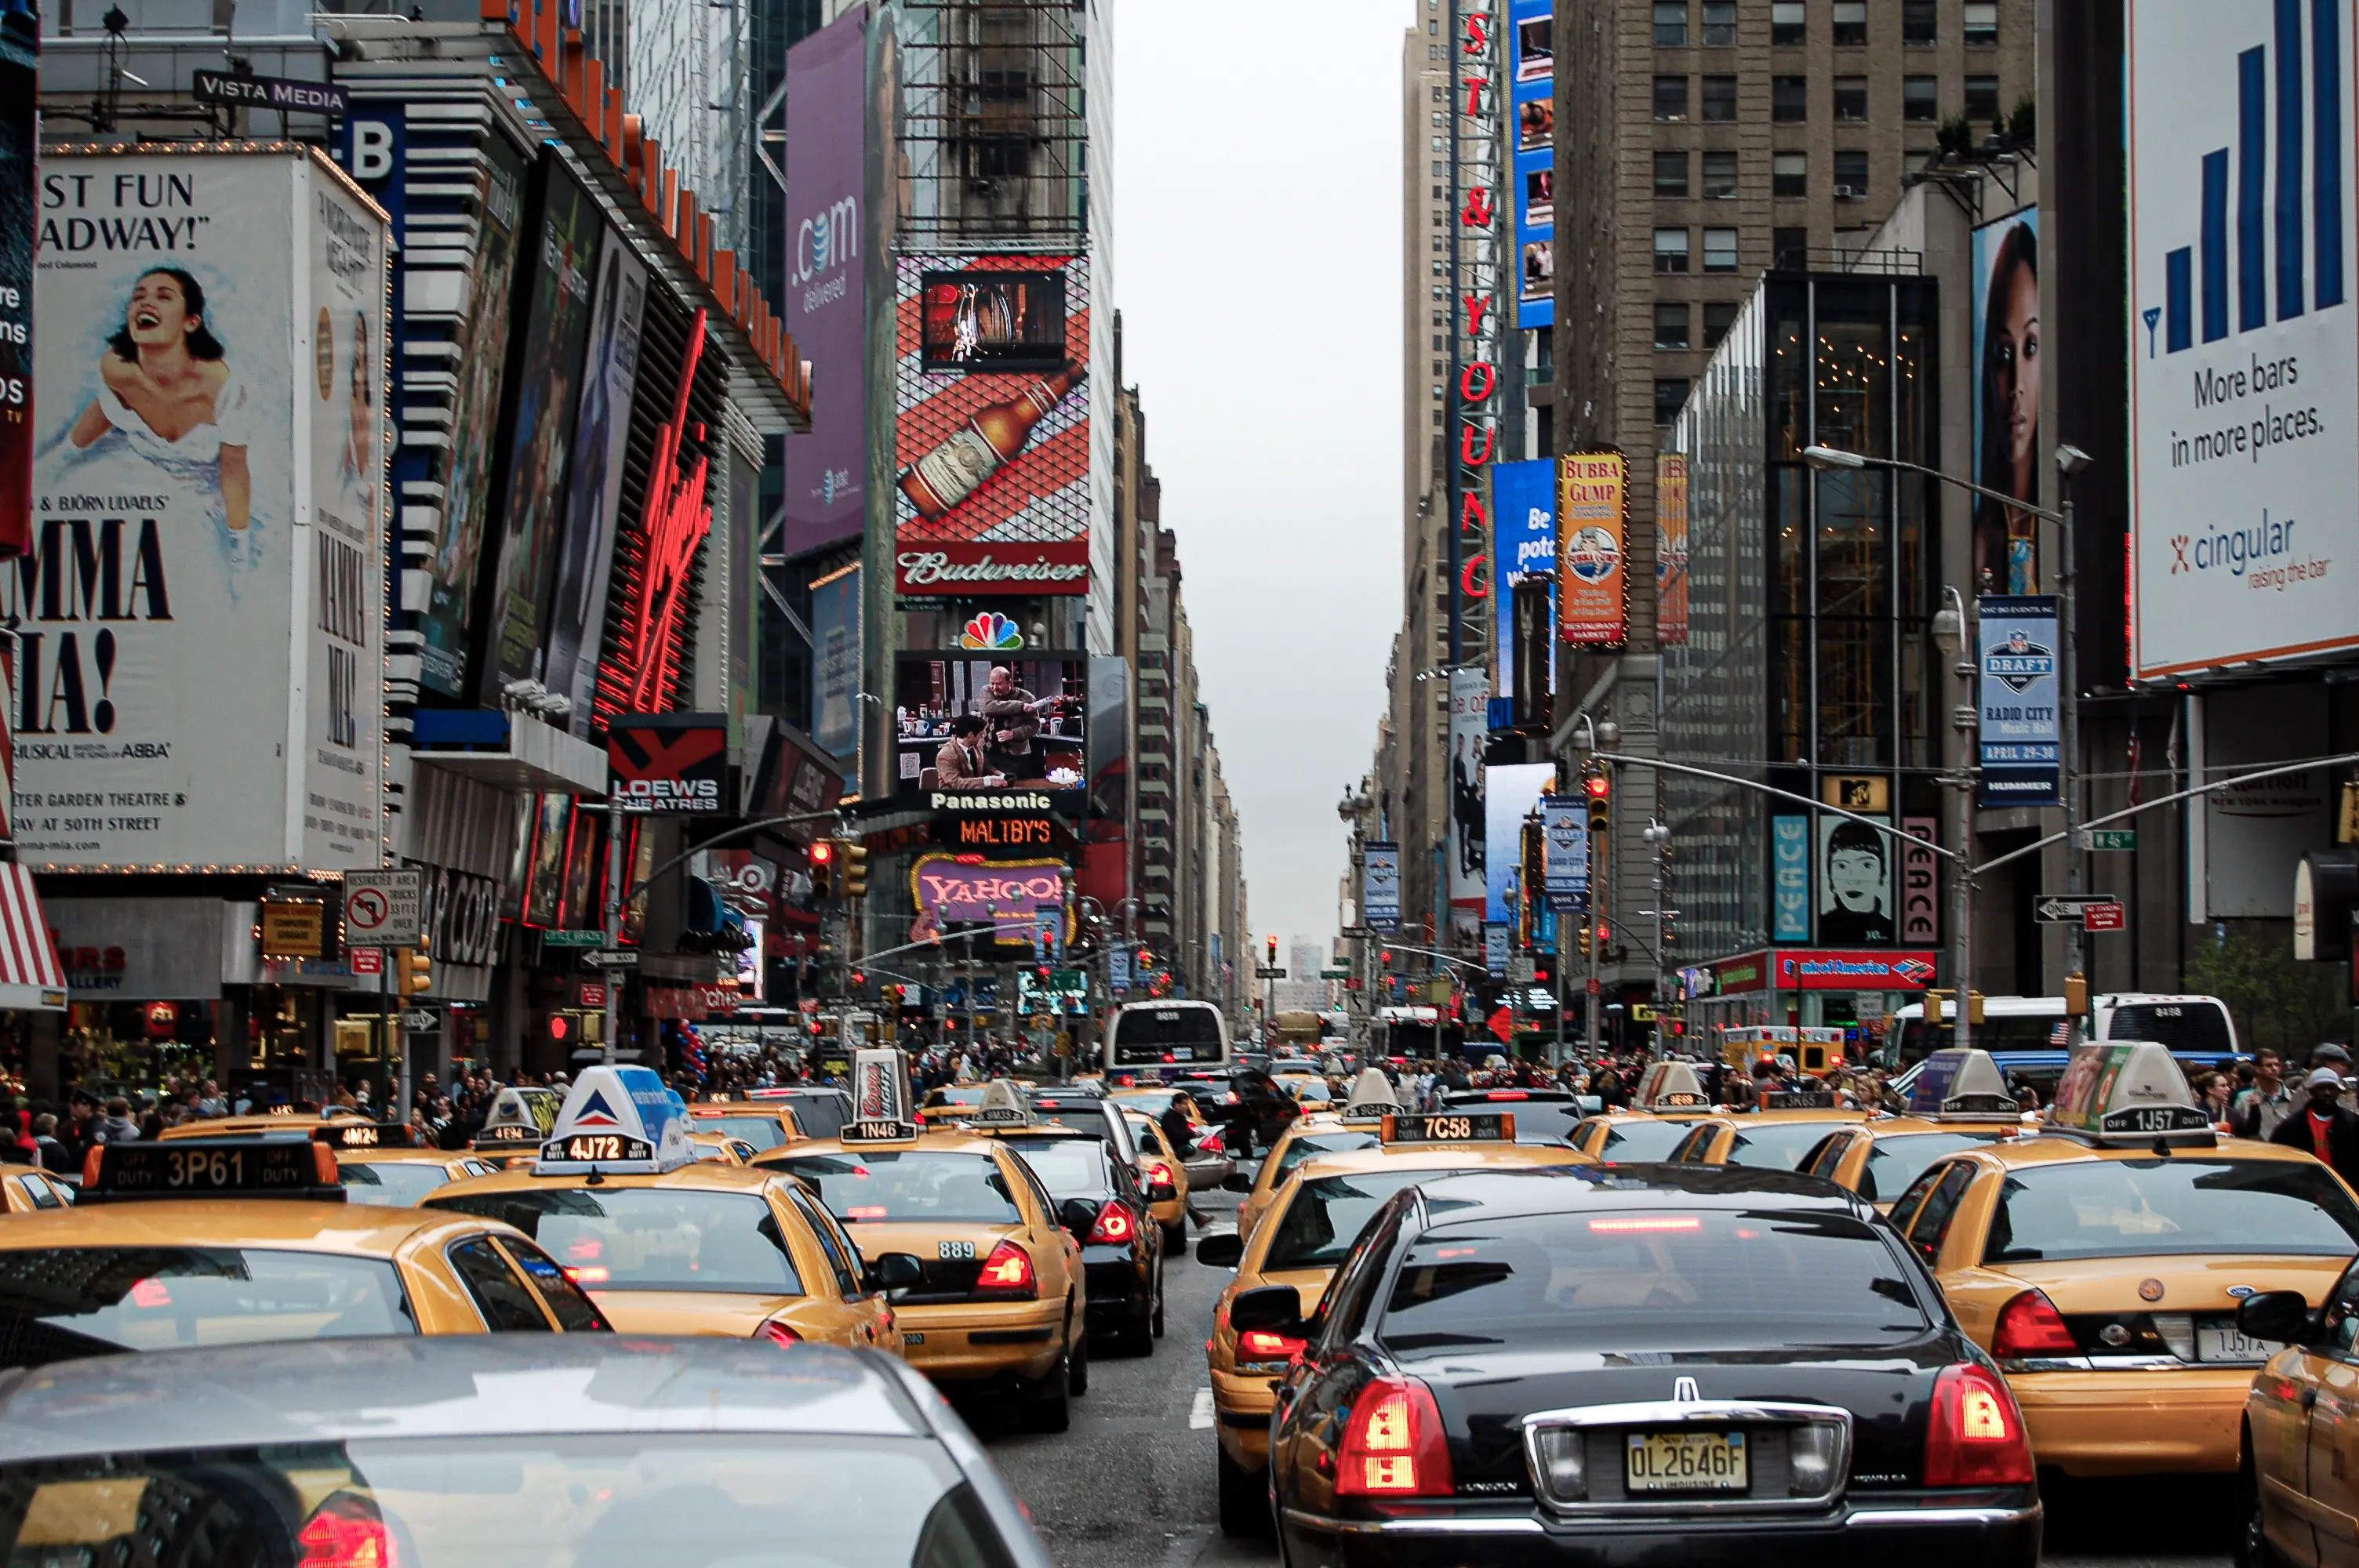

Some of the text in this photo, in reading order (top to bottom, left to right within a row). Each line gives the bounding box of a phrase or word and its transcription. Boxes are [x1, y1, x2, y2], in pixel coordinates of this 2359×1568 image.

[202, 76, 343, 111] VISTA MEDIA
[43, 173, 193, 209] ST FUN
[803, 270, 847, 313] delivered
[2194, 353, 2299, 408] More bars
[2171, 405, 2324, 467] in more places.
[1565, 459, 1619, 479] BUBBA
[40, 496, 52, 511] &
[59, 494, 106, 511] BJÖRN
[1569, 483, 1616, 503] GUMP
[1528, 508, 1550, 530] Be
[2194, 508, 2295, 576] cingular
[0, 518, 175, 621] MMA
[897, 551, 1087, 585] Budweiser
[2248, 555, 2329, 592] raising the bar
[1989, 659, 2049, 672] DRAFT
[1986, 706, 2053, 721] RADIO CITY
[1986, 746, 2019, 760] APRIL
[614, 779, 718, 797] LOEWS
[48, 793, 104, 807] GARDEN
[108, 793, 169, 807] THEATRE
[931, 793, 1051, 809] Panasonic
[42, 818, 60, 831] AT
[64, 818, 103, 831] 50TH
[107, 818, 161, 831] STREET
[961, 820, 1051, 844] MALTBY'S
[396, 874, 417, 885] AREA
[1776, 822, 1804, 933] PEACE
[1906, 825, 1933, 934] PEACE
[921, 874, 1063, 904] YAHOO!
[2046, 903, 2070, 915] ONE
[394, 919, 413, 929] OVER
[1784, 959, 1819, 975] Bnk
[1836, 960, 1889, 975] America
[862, 1062, 881, 1117] Coors
[860, 1122, 896, 1138] 1N46
[1423, 1116, 1471, 1138] 7C58
[2107, 1119, 2127, 1128] OFF
[2135, 1110, 2174, 1131] 1J57
[342, 1127, 378, 1144] 4M24
[569, 1136, 620, 1160] 4J72
[122, 1150, 293, 1167] OFF OFF
[168, 1151, 243, 1185] 3P61
[118, 1167, 299, 1185] DUTY DUTY
[940, 1241, 975, 1258] 889
